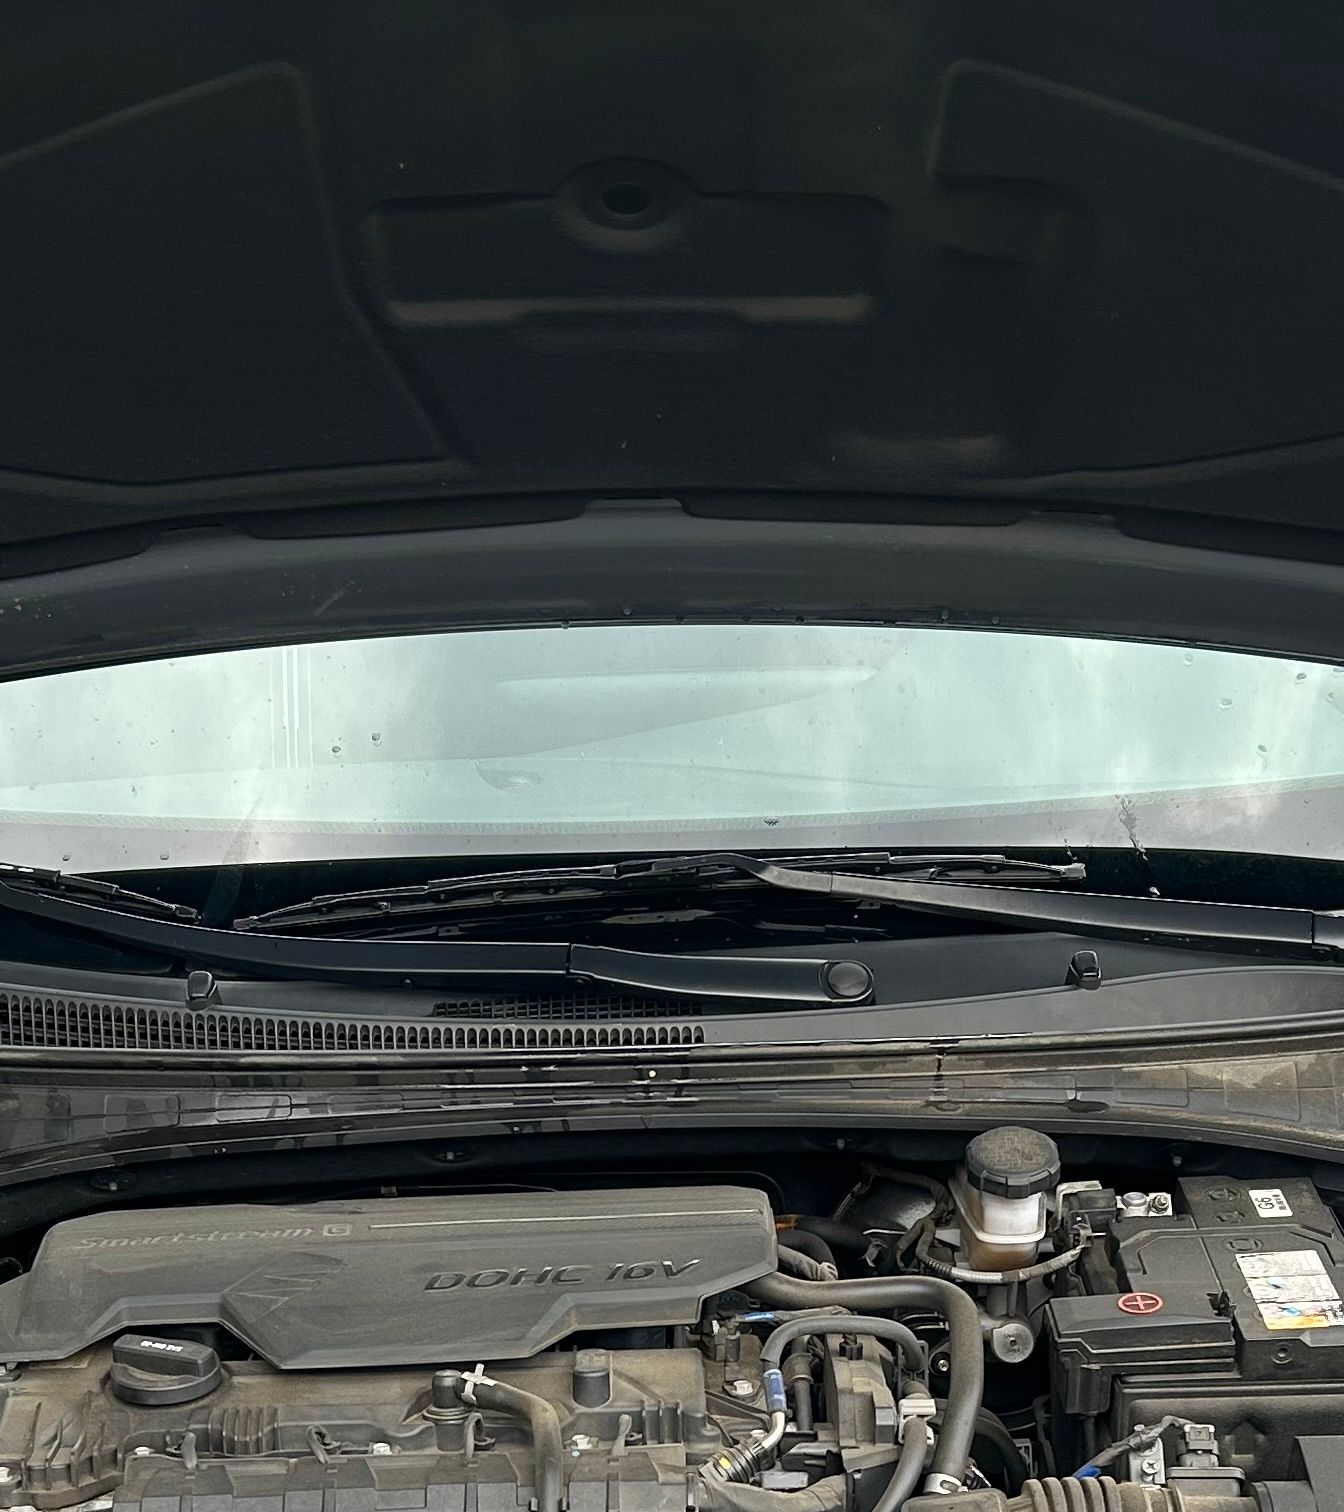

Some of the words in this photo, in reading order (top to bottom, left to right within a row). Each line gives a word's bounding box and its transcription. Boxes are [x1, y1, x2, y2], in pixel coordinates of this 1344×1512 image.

[78, 1228, 313, 1250] Smartstream
[423, 1264, 593, 1293] DOHC
[606, 1258, 701, 1280] 16V
